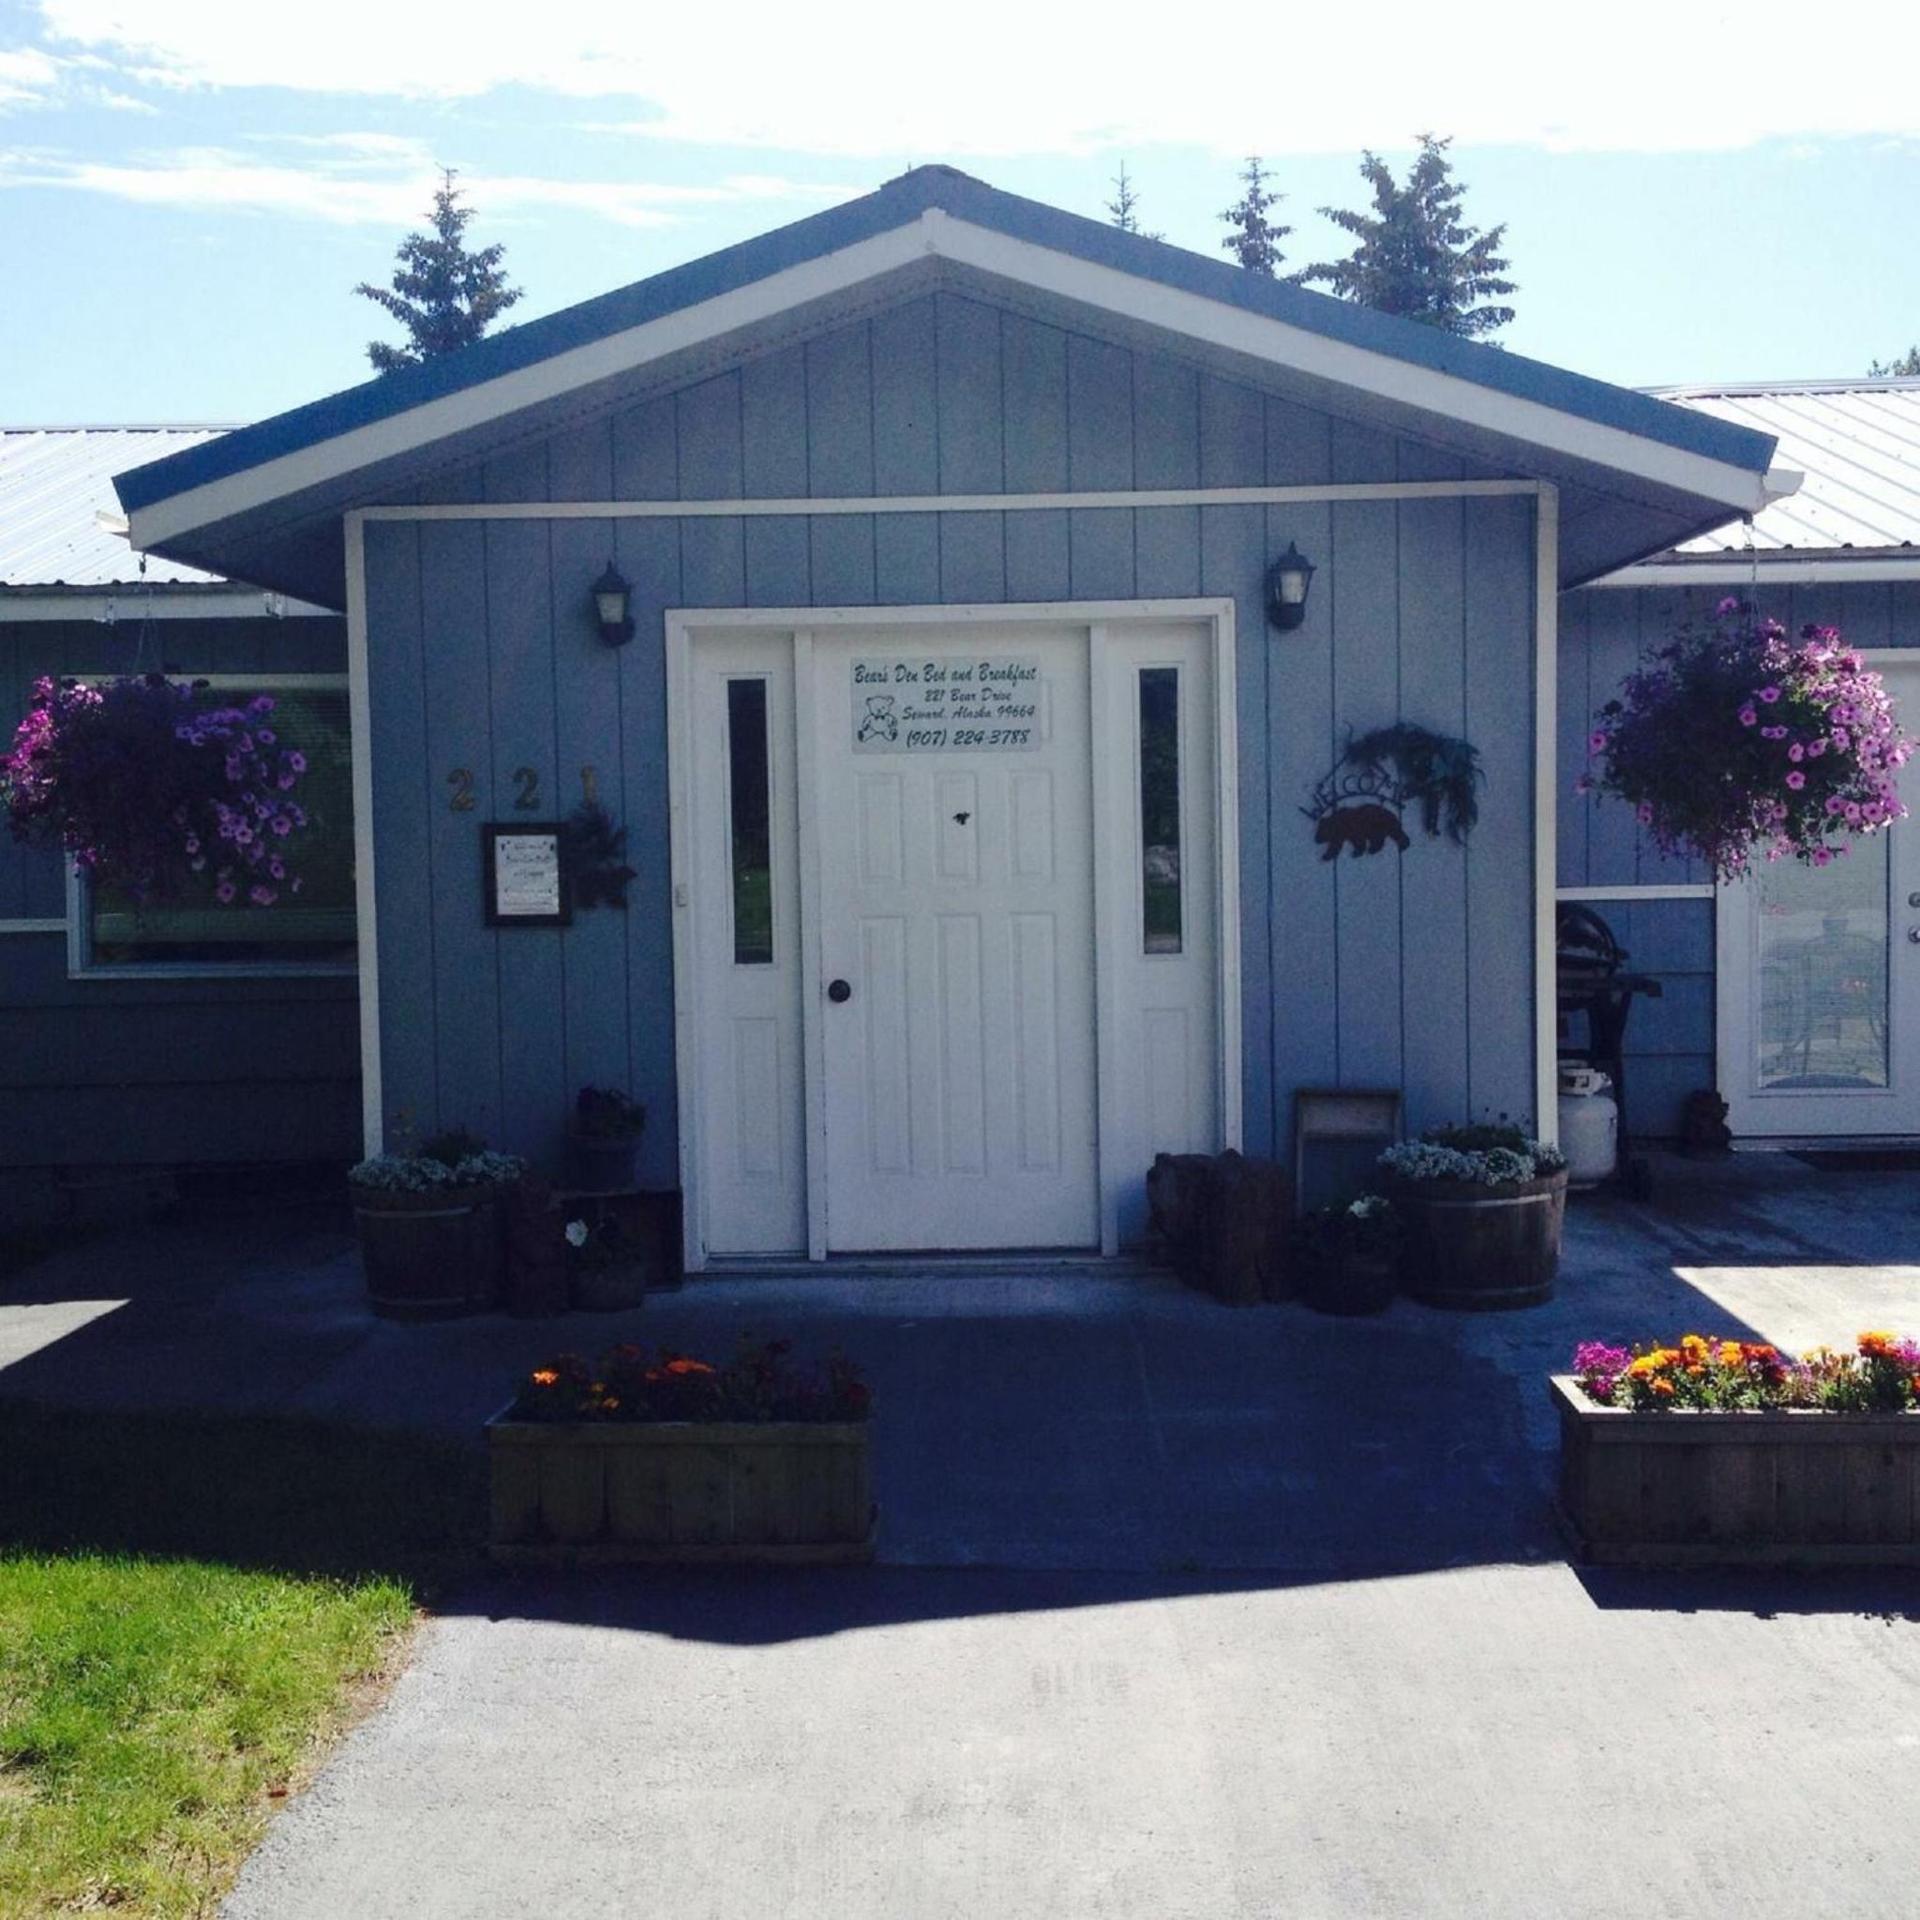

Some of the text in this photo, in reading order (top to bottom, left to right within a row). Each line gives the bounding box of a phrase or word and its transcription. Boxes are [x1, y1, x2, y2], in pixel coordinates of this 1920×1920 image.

[895, 663, 919, 683] Den
[923, 663, 947, 682] Bed
[951, 665, 974, 681] and
[978, 662, 1036, 688] Breakfast
[924, 687, 1012, 702] 221 Bear Drive
[952, 705, 992, 719] Alaska
[997, 704, 1035, 717] 99664
[906, 728, 947, 748] (907)
[448, 766, 597, 811] 221
